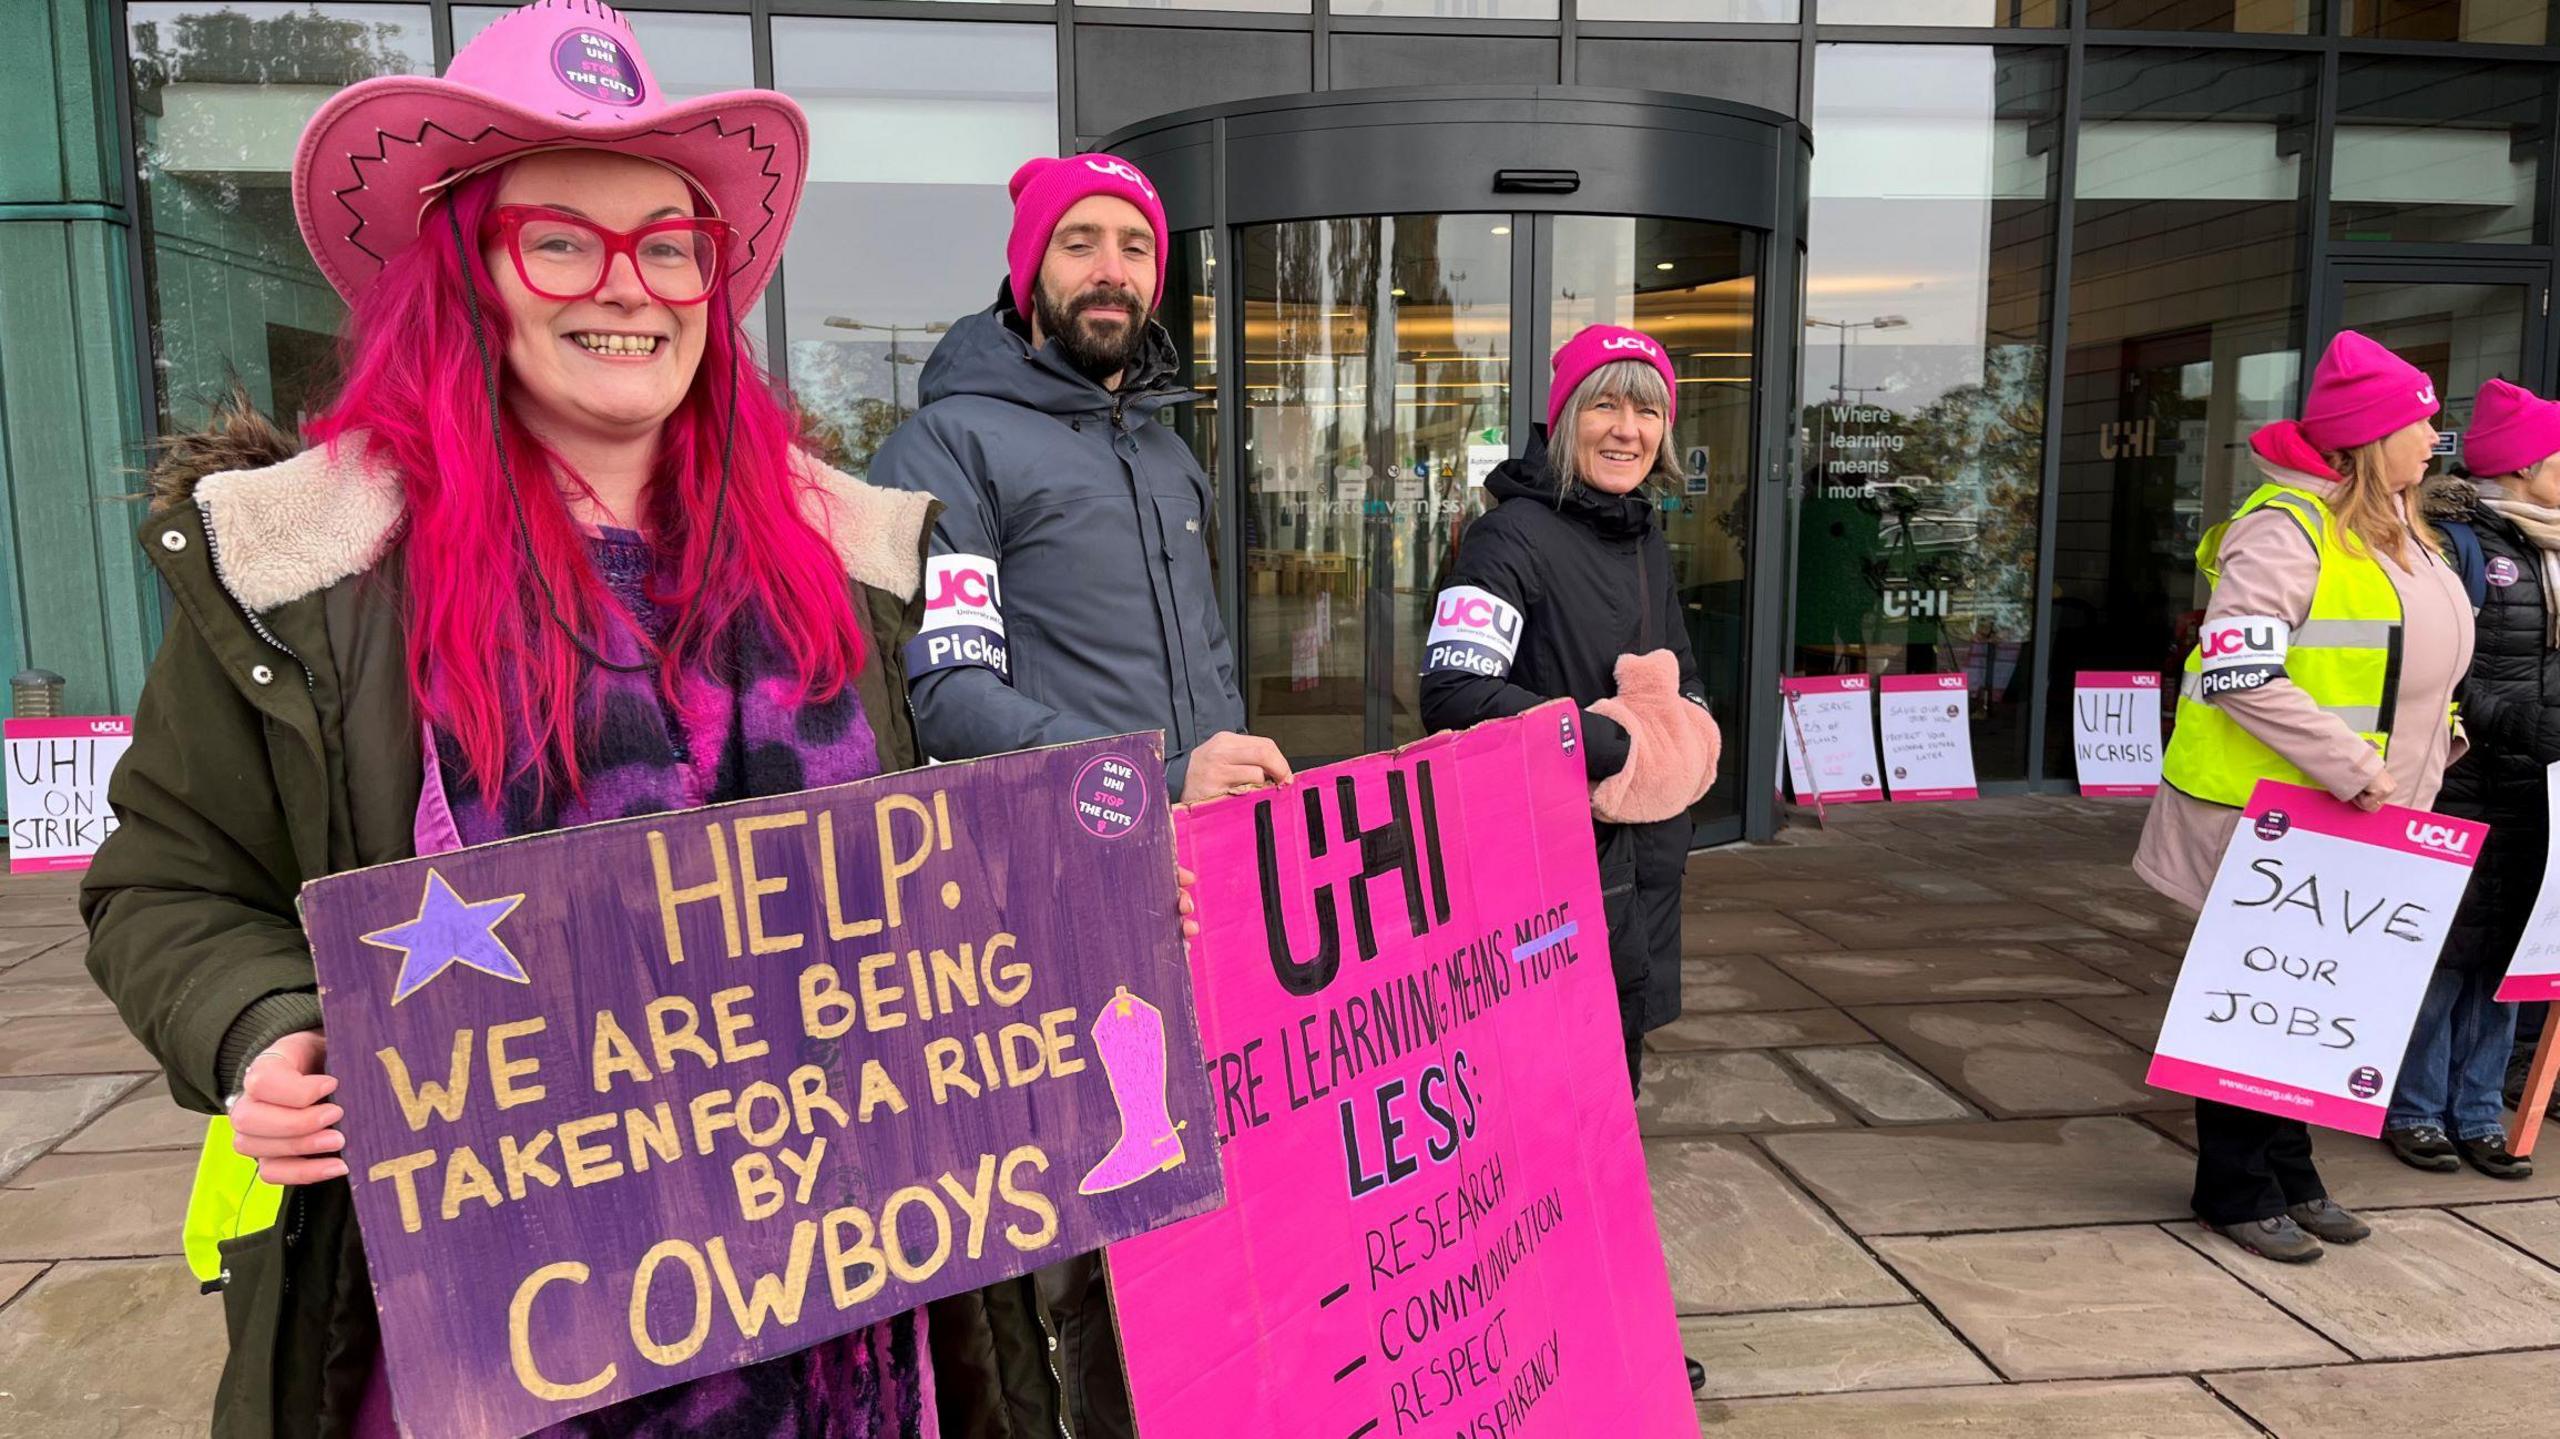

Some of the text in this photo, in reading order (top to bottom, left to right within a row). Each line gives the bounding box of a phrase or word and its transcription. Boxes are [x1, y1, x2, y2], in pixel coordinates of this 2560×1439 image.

[580, 33, 616, 53] SAVE
[586, 47, 613, 63] UHI
[566, 70, 635, 97] THE CUTS
[580, 60, 620, 77] STOP
[1831, 405, 1891, 423] Where
[1829, 431, 1904, 451] learning
[2100, 416, 2156, 460] UHI
[1828, 459, 1889, 475] means
[1828, 484, 1876, 500] more
[1882, 590, 1948, 617] UHI
[928, 633, 1008, 674] Picket
[1429, 645, 1503, 677] Picket
[2203, 668, 2270, 695] Picket
[2078, 692, 2134, 737] UHI
[13, 739, 95, 787] UHI
[1102, 761, 1132, 779] SAVE
[2078, 743, 2153, 762] IN CRISIS
[1093, 791, 1125, 808] STOP
[1102, 776, 1125, 792] UHI
[44, 790, 93, 817] ON
[1079, 800, 1132, 826] THE CUTS
[645, 789, 963, 965] HELP!
[1254, 760, 1451, 996] UHI
[2231, 857, 2430, 943] SAVE
[2242, 945, 2339, 986] OUR
[1280, 964, 1451, 1112] LEARNING
[1444, 928, 1511, 1028] MEANS
[1513, 901, 1579, 989] MORE
[2204, 988, 2361, 1050] JOBS
[375, 932, 1033, 1131] WE ARE BEING
[368, 1007, 1080, 1234] TAKEN FOR A RIDE
[731, 1136, 828, 1223] BY
[1365, 1151, 1506, 1291] RESEARCH
[507, 1144, 1060, 1402] COWBOYS
[1379, 1187, 1563, 1362] COMMUNICATION
[1390, 1308, 1509, 1437] RESPECT
